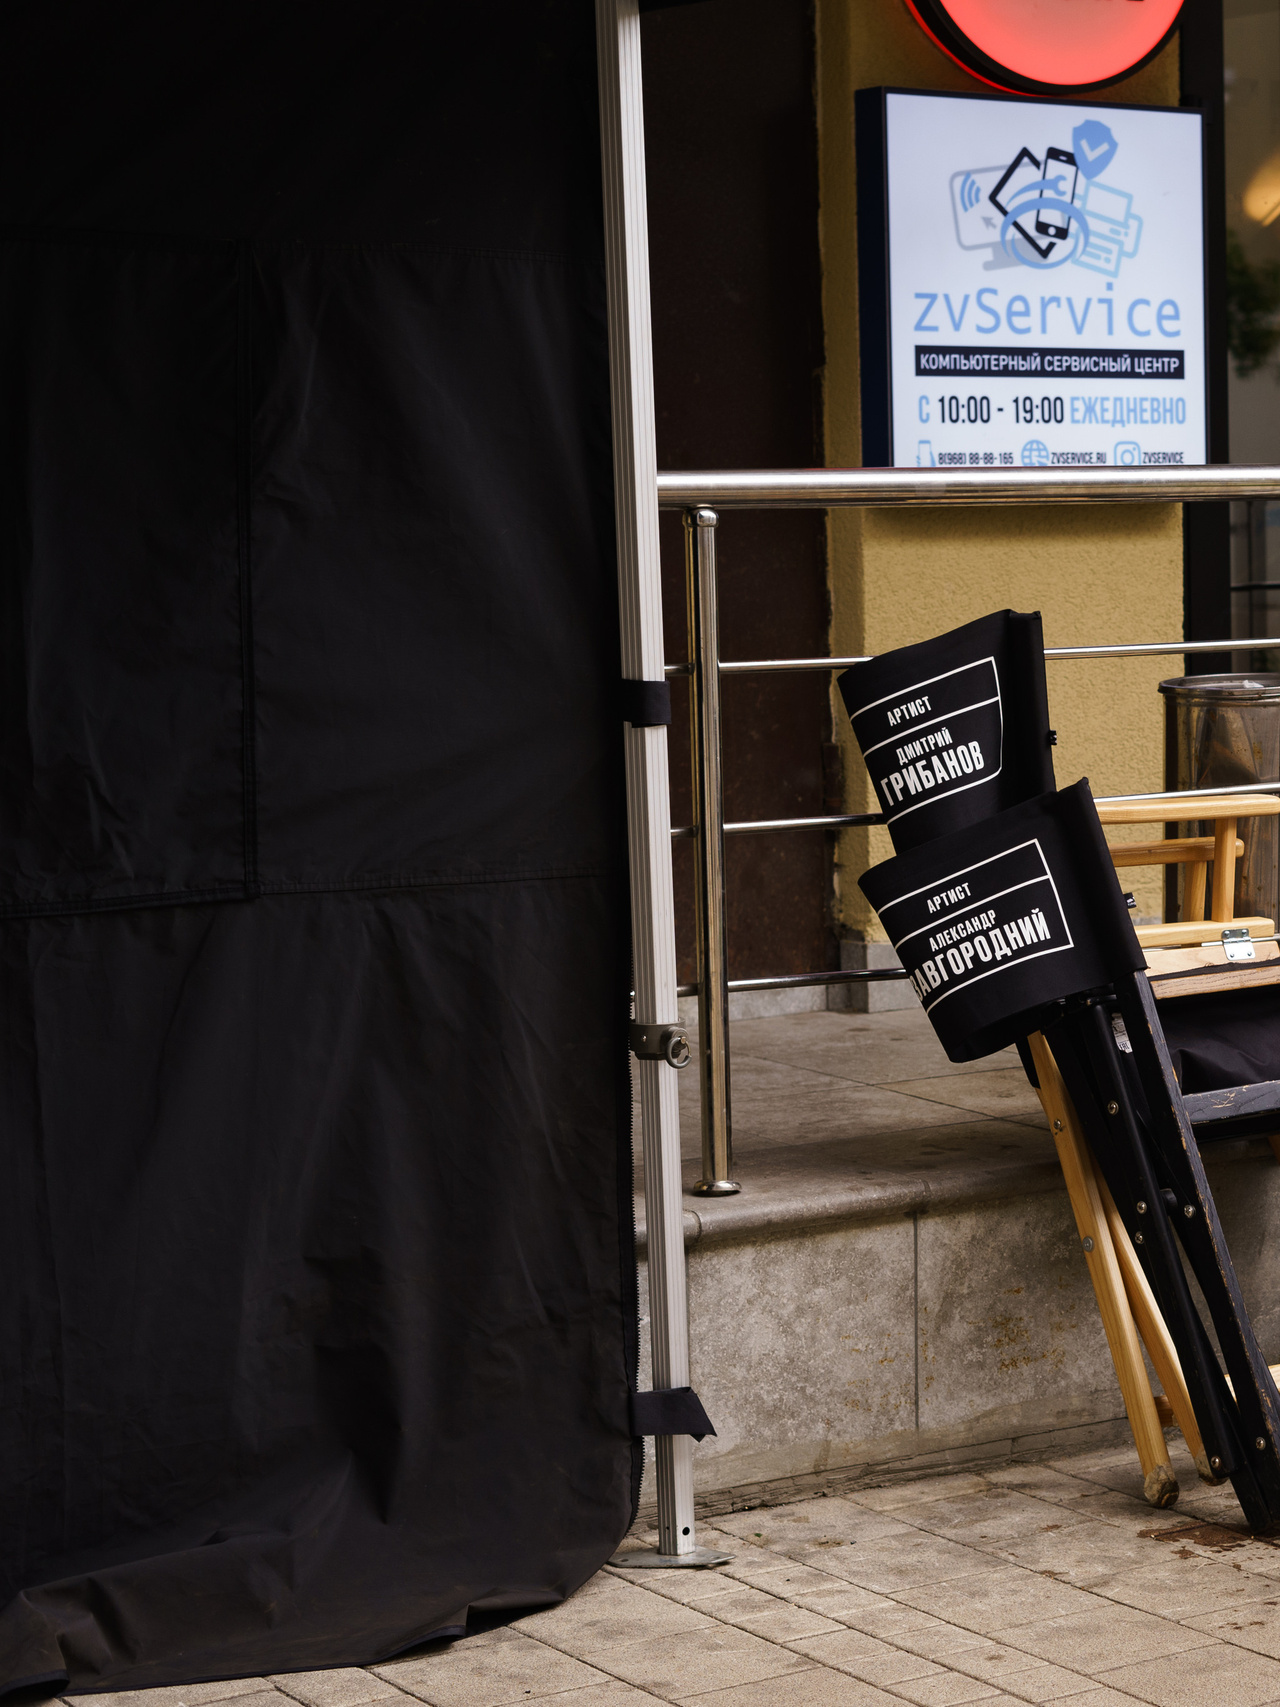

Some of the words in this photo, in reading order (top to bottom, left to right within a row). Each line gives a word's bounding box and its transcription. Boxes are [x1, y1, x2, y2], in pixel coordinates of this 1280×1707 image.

[914, 281, 1181, 338] zvService
[920, 352, 1042, 372] КОМПЬЮТЕРНЫЙ
[1044, 353, 1131, 373] СЕРВИСНЫЙ
[1134, 357, 1180, 376] ЦЕНТР
[938, 395, 991, 424] 10:00
[1012, 396, 1064, 424] 19:00
[1070, 396, 1187, 428] ЕЖЕДНЕВНО
[1050, 452, 1107, 465] ZVSERVICE.RU
[1142, 452, 1184, 465] ZVSERVICE
[886, 696, 932, 727] АРТИСТ
[895, 727, 953, 766] ДМИТРИЙ
[880, 741, 985, 807] ГРИБАНОВ
[926, 882, 972, 914] АРТИСТ
[929, 909, 997, 952] АЛЕКСАНДР
